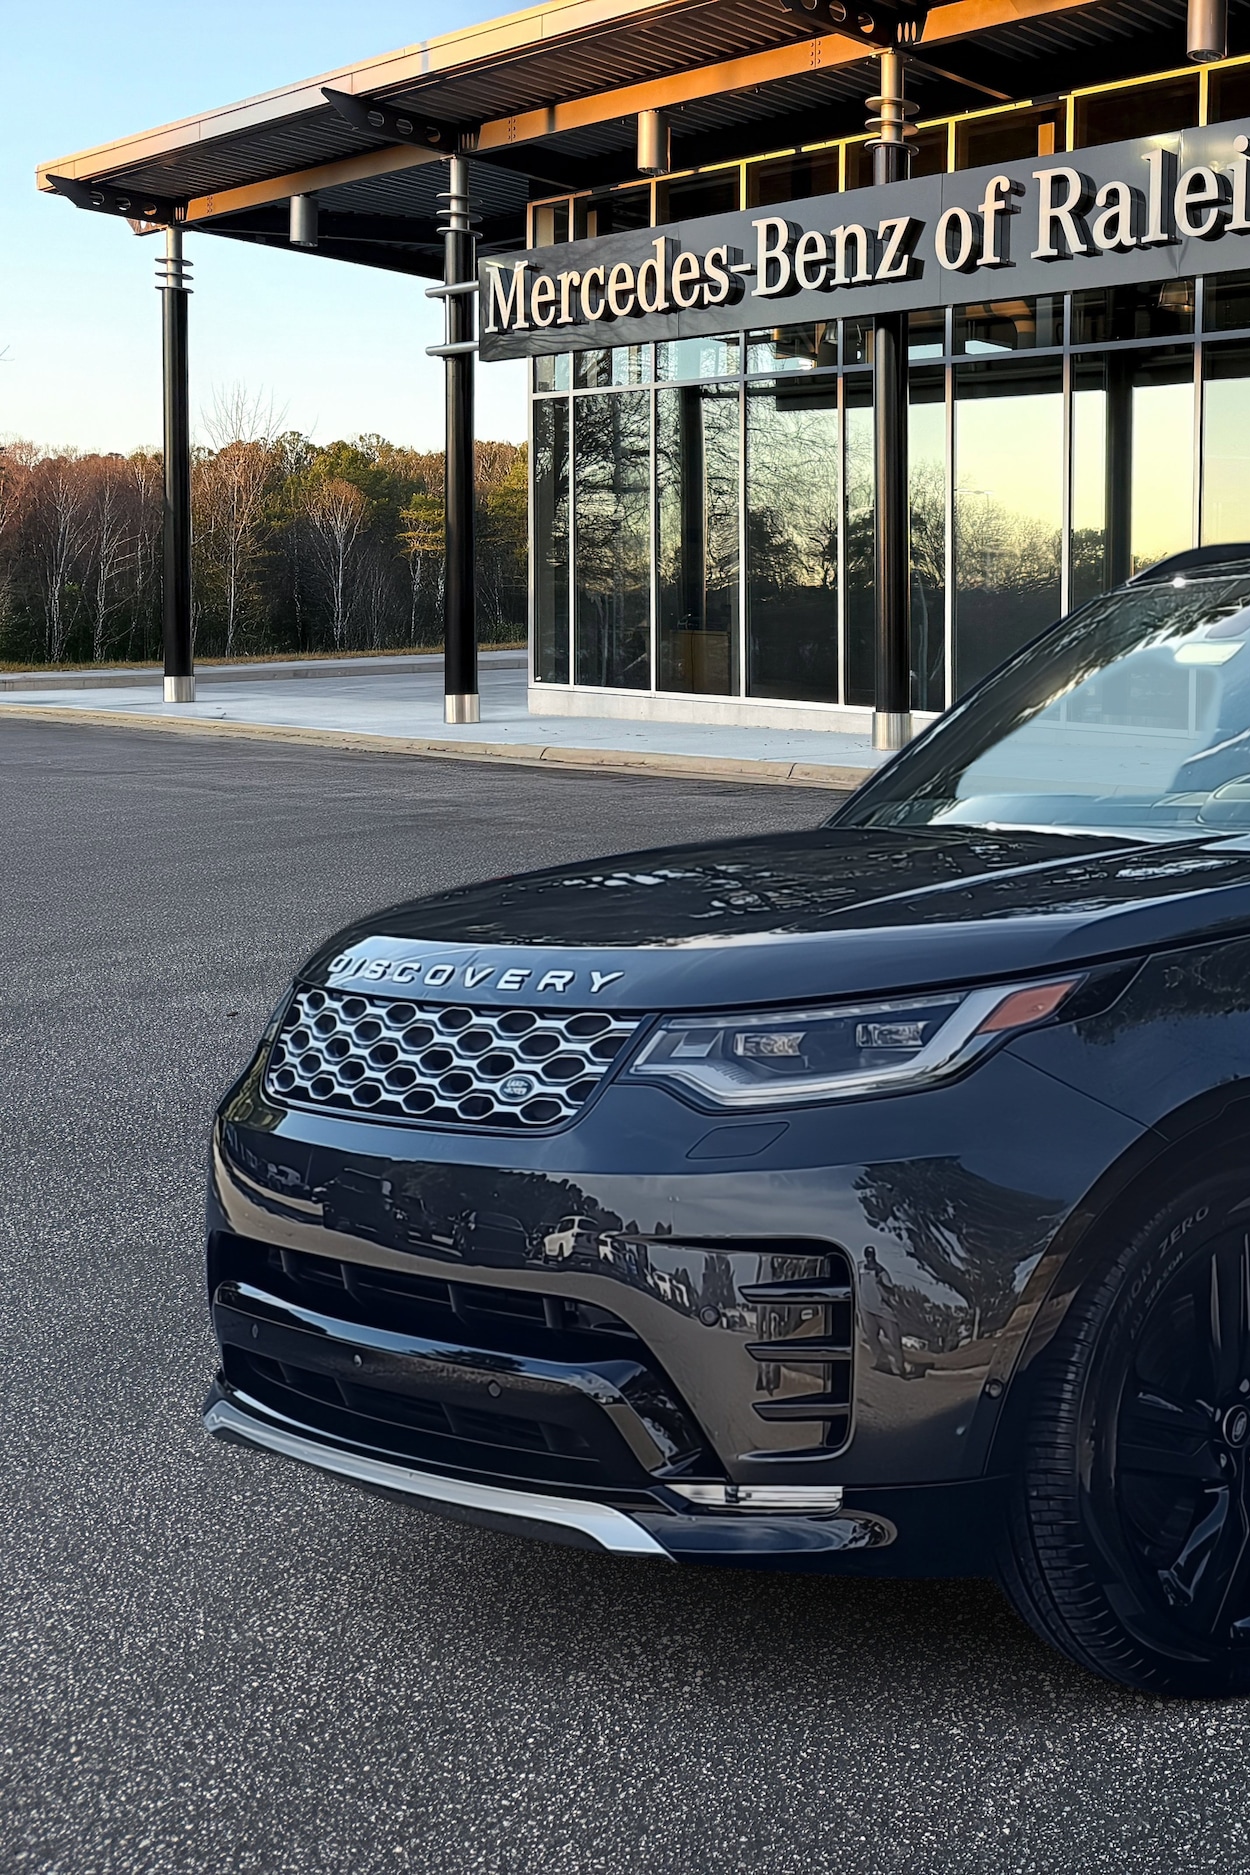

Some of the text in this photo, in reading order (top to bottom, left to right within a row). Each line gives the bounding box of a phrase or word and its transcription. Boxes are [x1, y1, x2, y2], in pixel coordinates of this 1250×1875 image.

[484, 216, 918, 334] Mercedes-Benz
[934, 174, 1013, 272] of
[327, 953, 625, 993] DISCOVERY
[1157, 1205, 1210, 1260] ZERO
